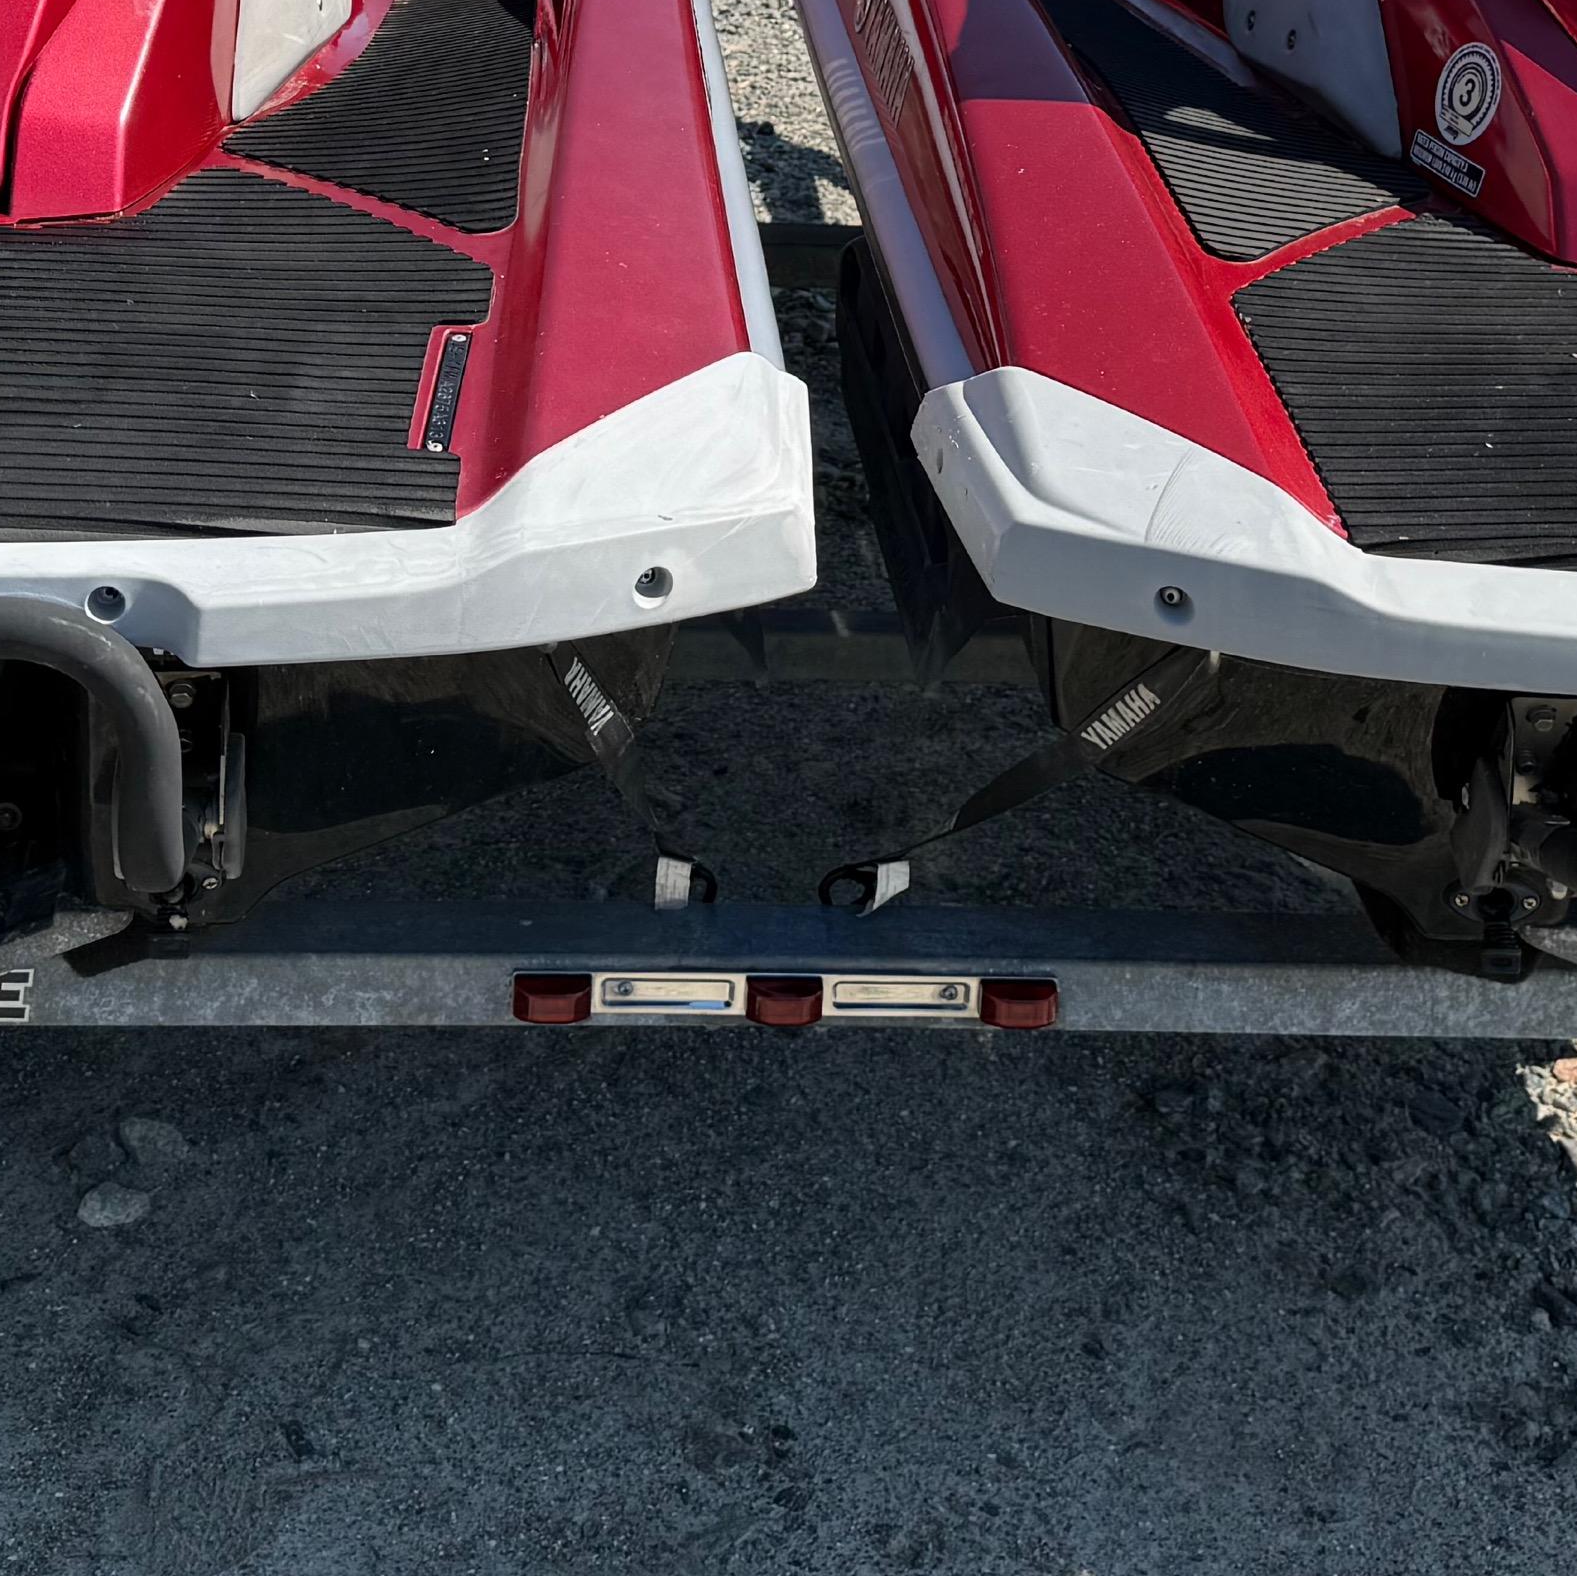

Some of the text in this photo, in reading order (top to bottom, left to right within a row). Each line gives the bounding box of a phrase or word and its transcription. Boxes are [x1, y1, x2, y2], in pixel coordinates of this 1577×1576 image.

[1459, 77, 1475, 107] 3
[564, 656, 614, 736] YAMAHA
[1080, 683, 1161, 750] YAMAHA
